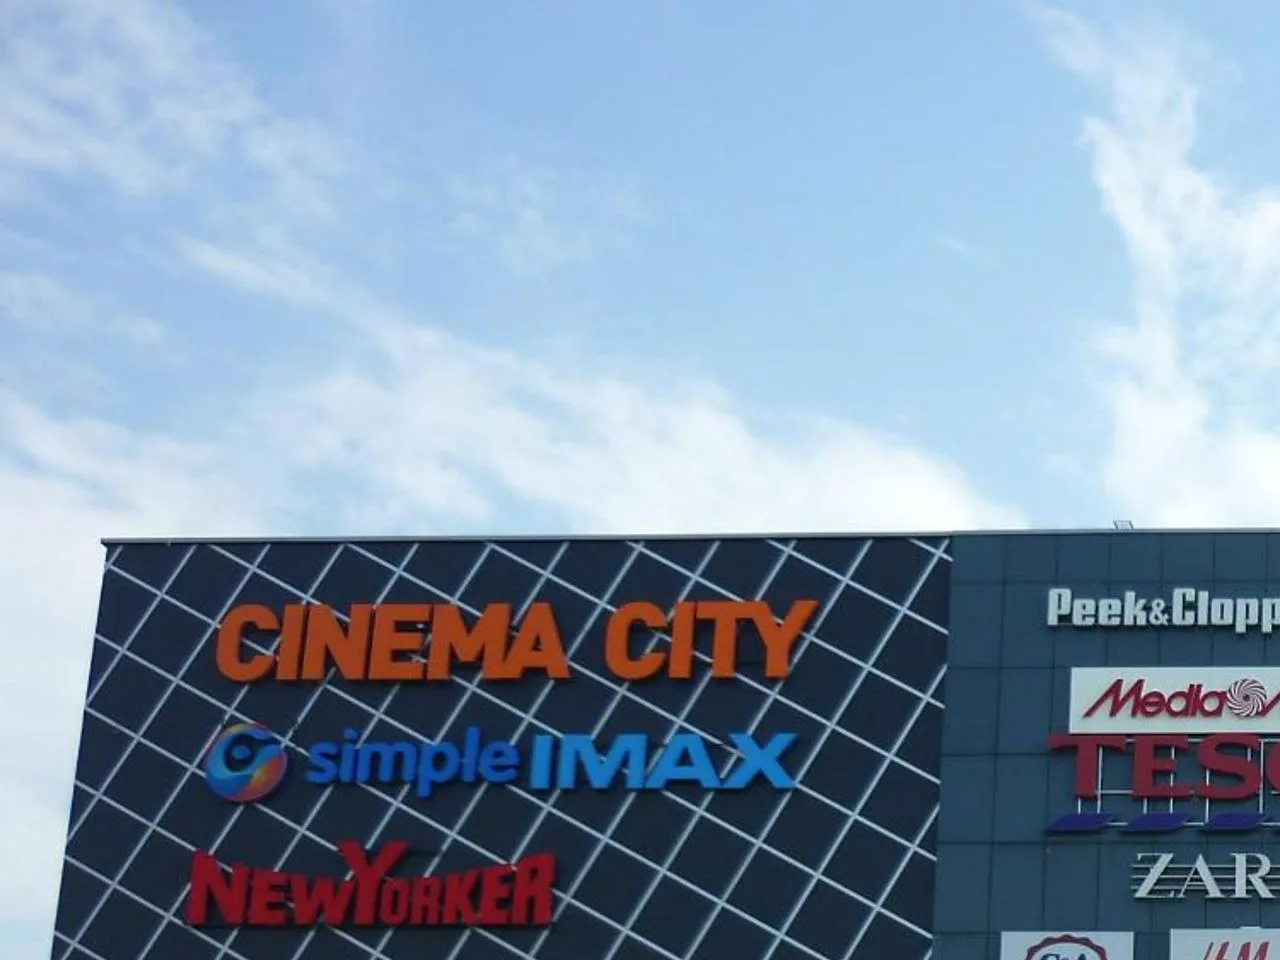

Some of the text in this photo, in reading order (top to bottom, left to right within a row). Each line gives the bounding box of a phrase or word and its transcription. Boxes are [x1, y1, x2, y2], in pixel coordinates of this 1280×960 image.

[215, 600, 817, 682] CINEMA CITY
[1083, 678, 1228, 718] Media
[307, 727, 797, 796] simple IMAX
